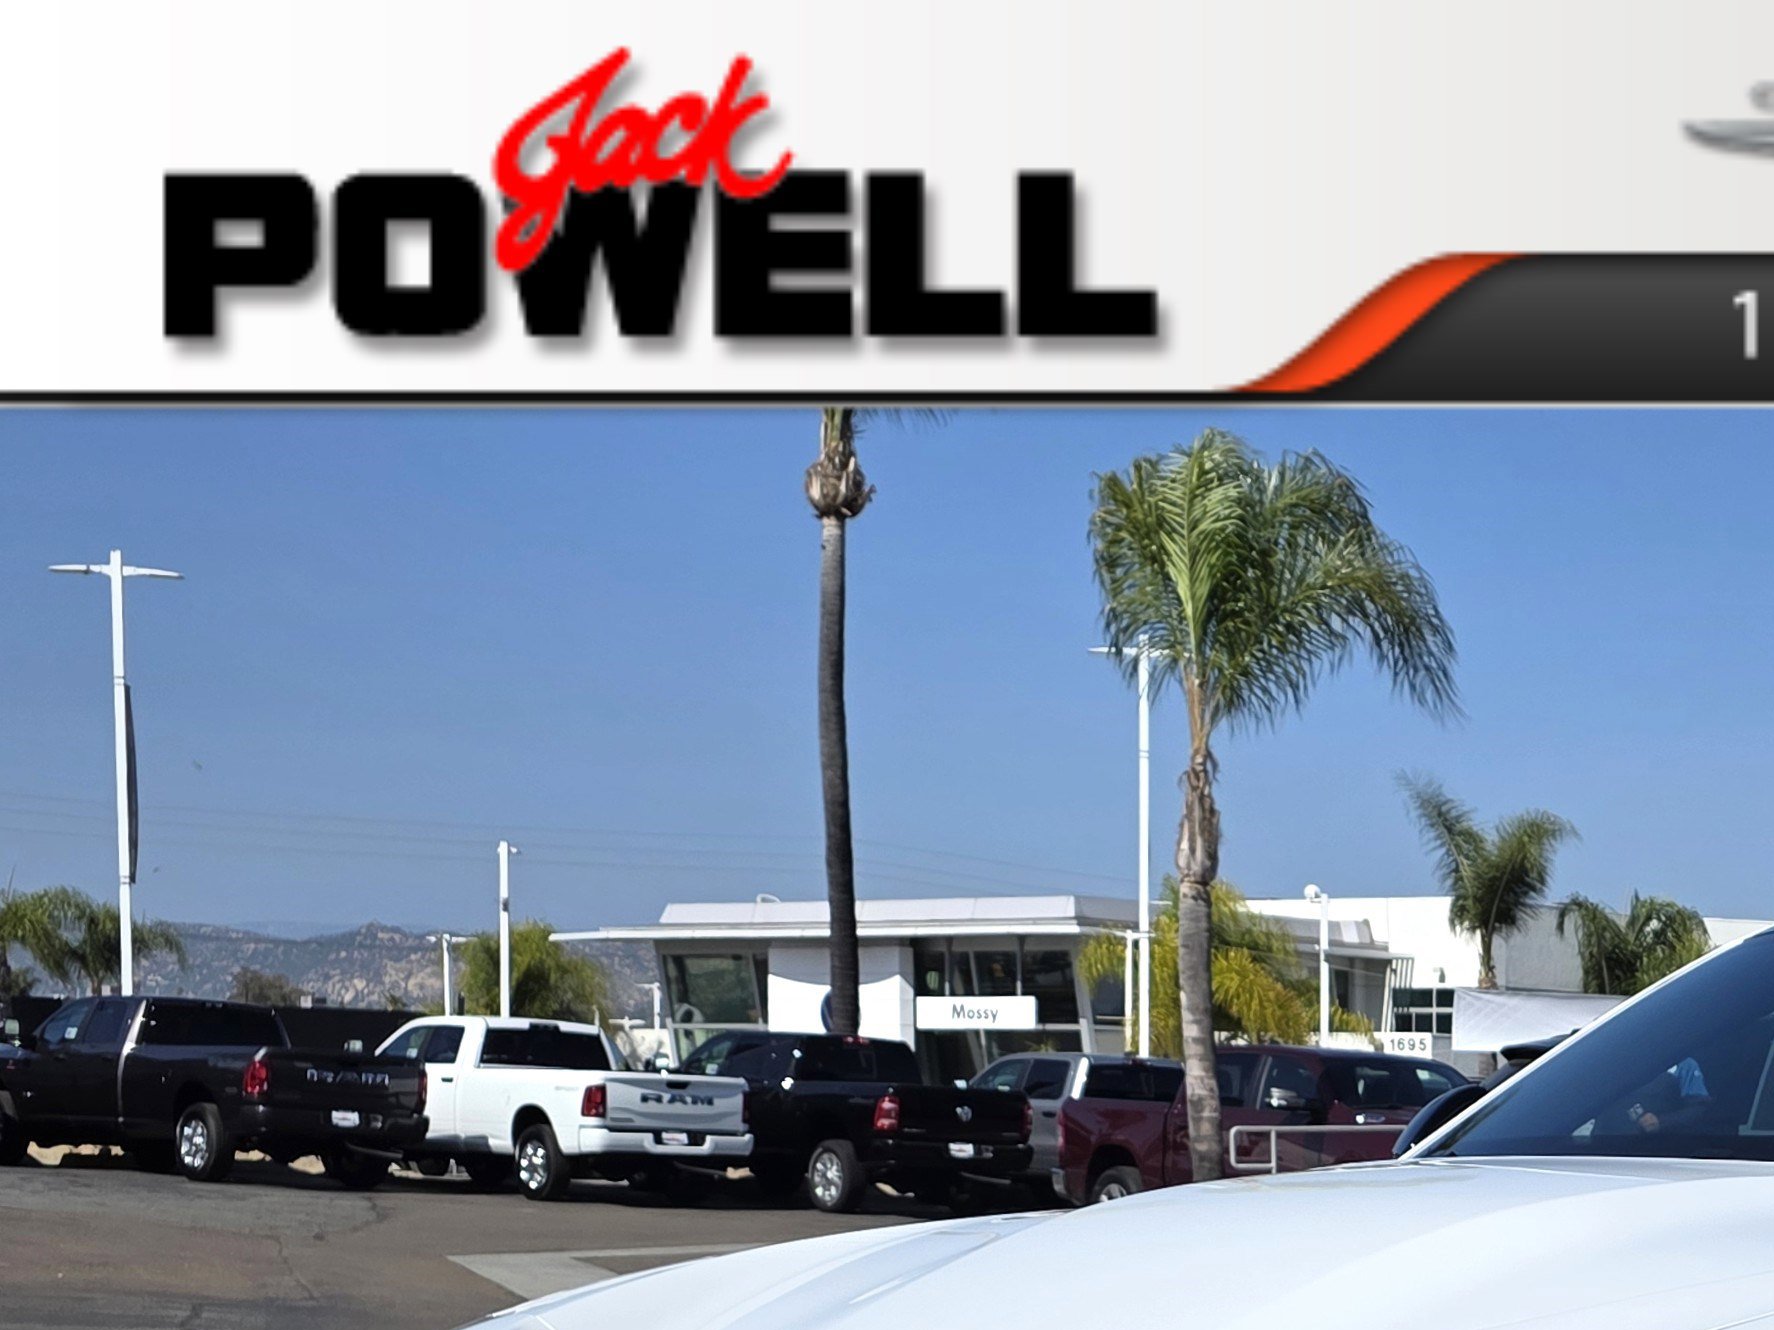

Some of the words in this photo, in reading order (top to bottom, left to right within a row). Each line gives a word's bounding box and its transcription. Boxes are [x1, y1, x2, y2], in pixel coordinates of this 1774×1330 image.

[951, 1003, 999, 1023] Mossy
[1390, 1038, 1427, 1051] 1695
[640, 1092, 715, 1107] RAM
